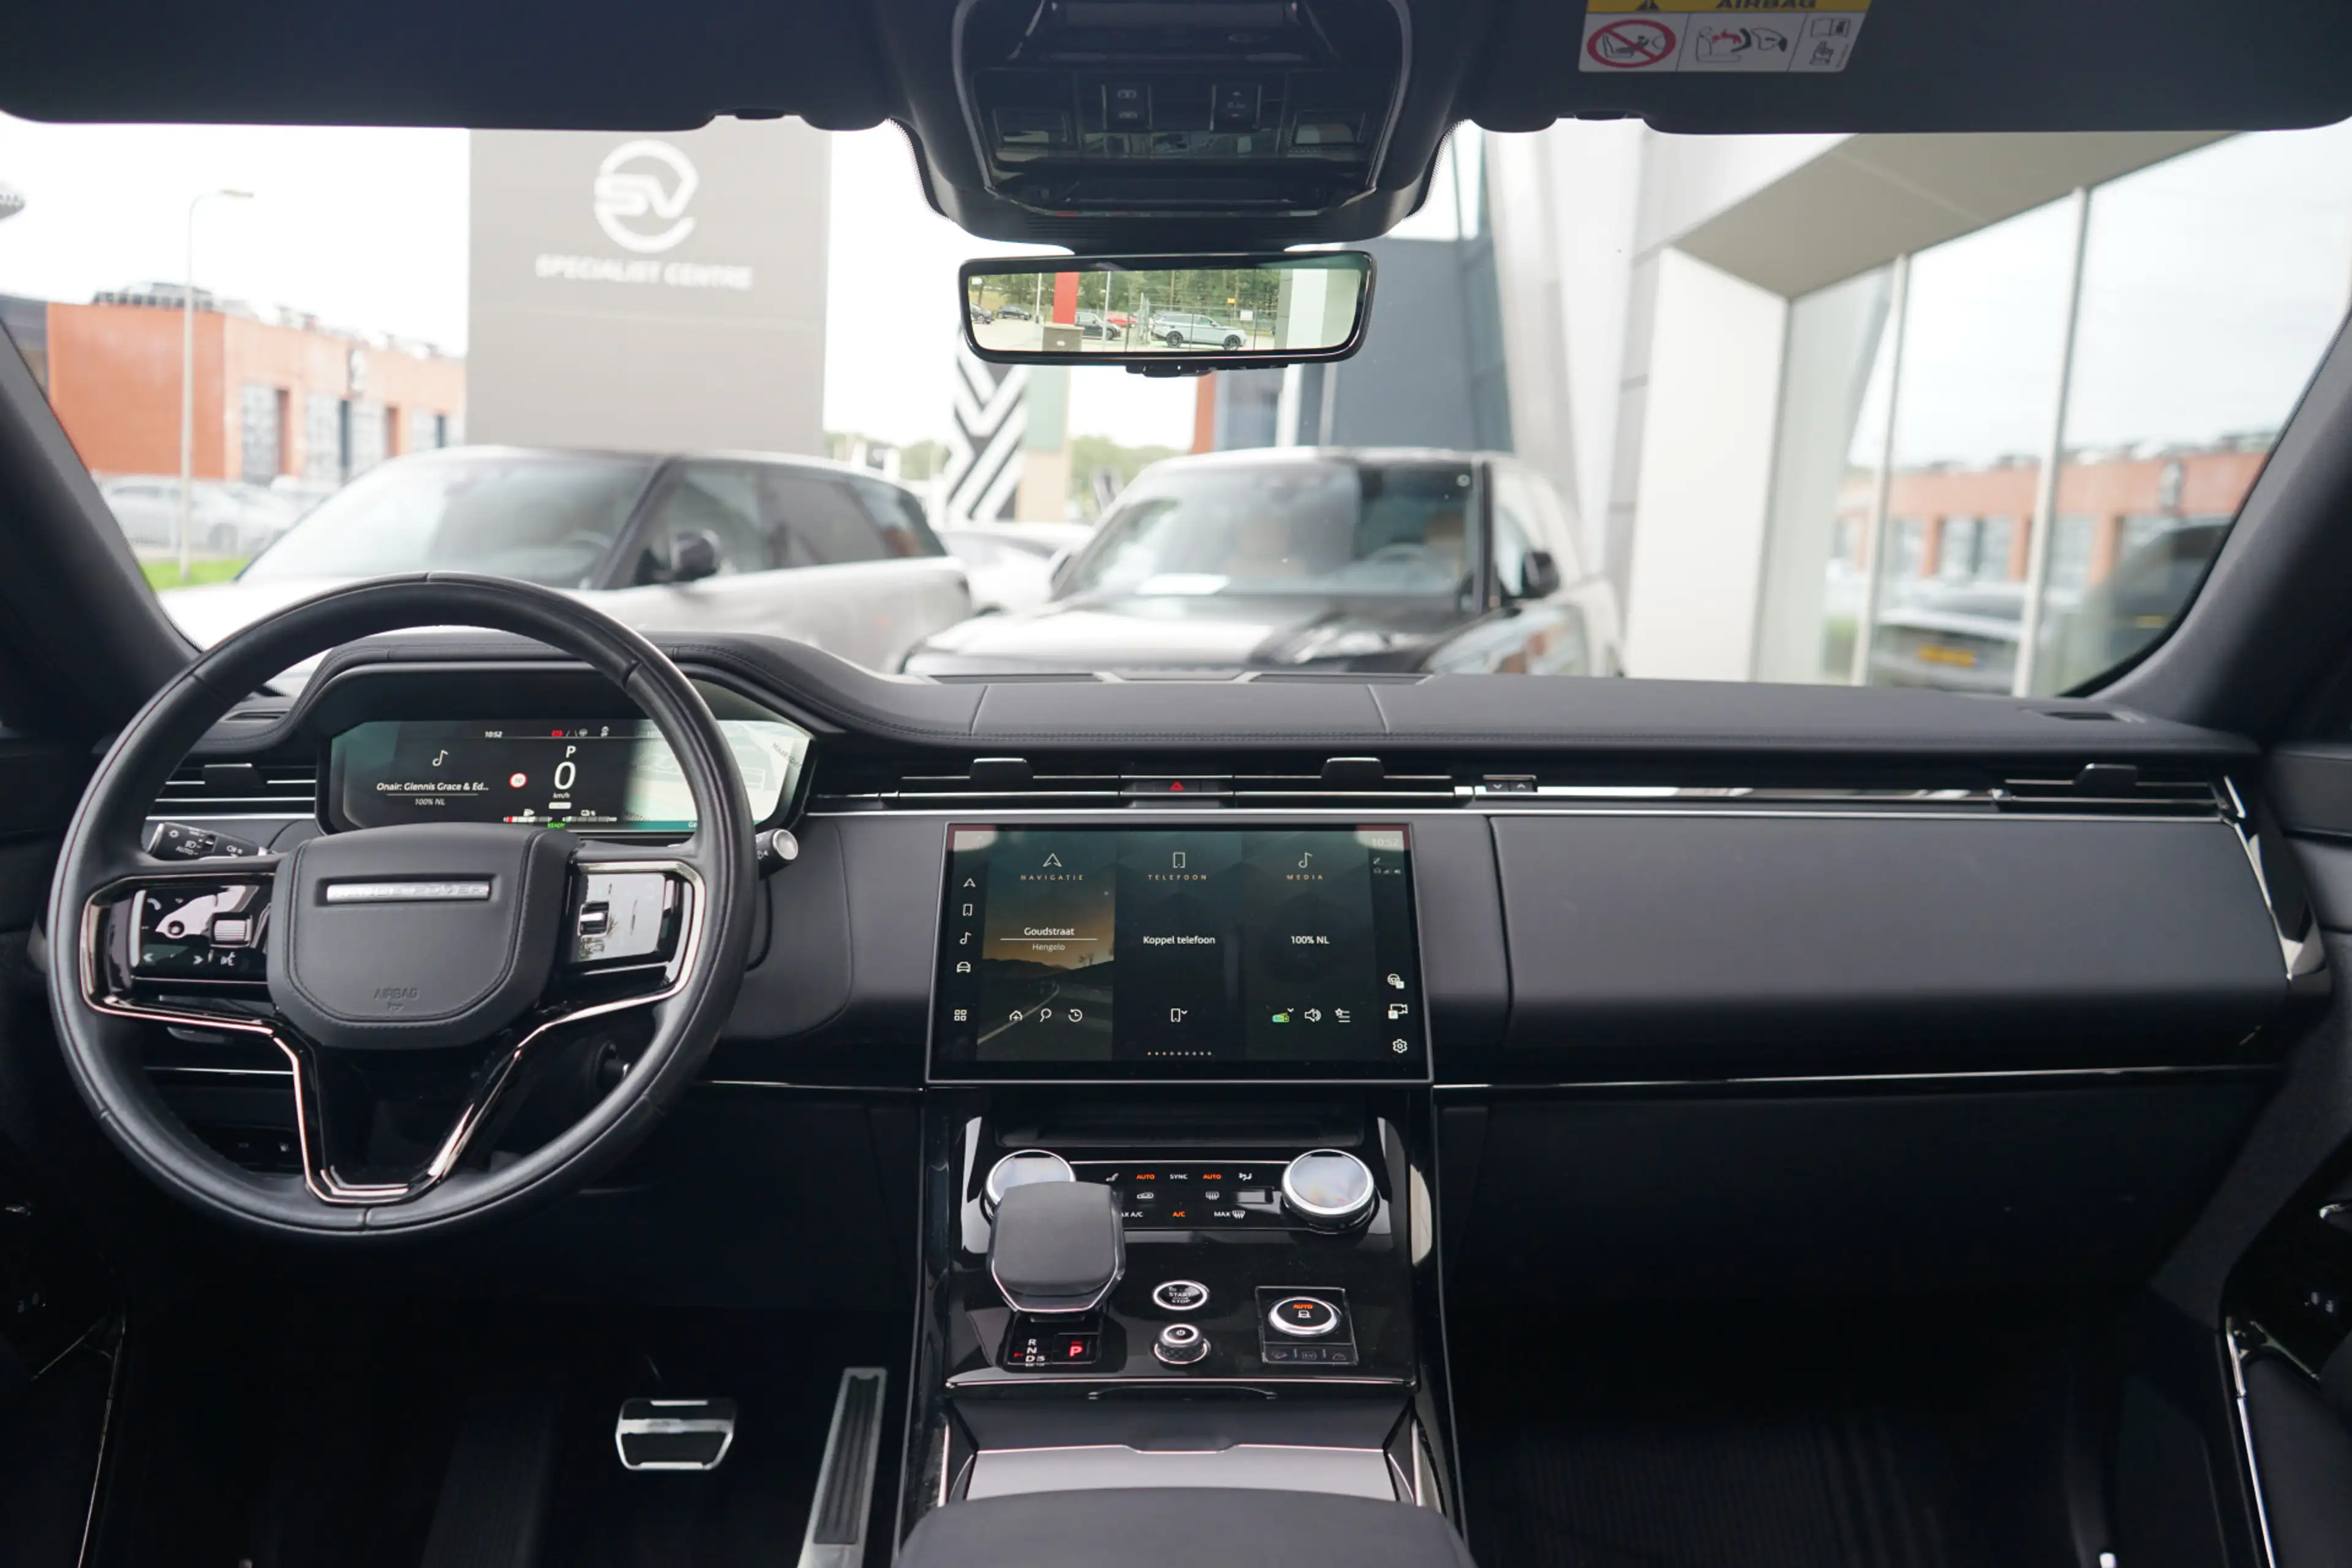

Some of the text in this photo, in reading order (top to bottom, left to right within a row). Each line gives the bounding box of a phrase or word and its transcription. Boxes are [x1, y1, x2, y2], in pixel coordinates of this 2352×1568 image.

[566, 745, 576, 758] P
[554, 761, 576, 790] 0
[437, 782, 461, 791] Grace
[1024, 927, 1075, 937] Goudstraat
[1142, 935, 1216, 945] Koppel telefoon
[1291, 936, 1330, 944] 100% NL
[1032, 943, 1066, 952] Hengelo
[374, 987, 419, 1000] AIRBAG
[1069, 1346, 1084, 1357] P
